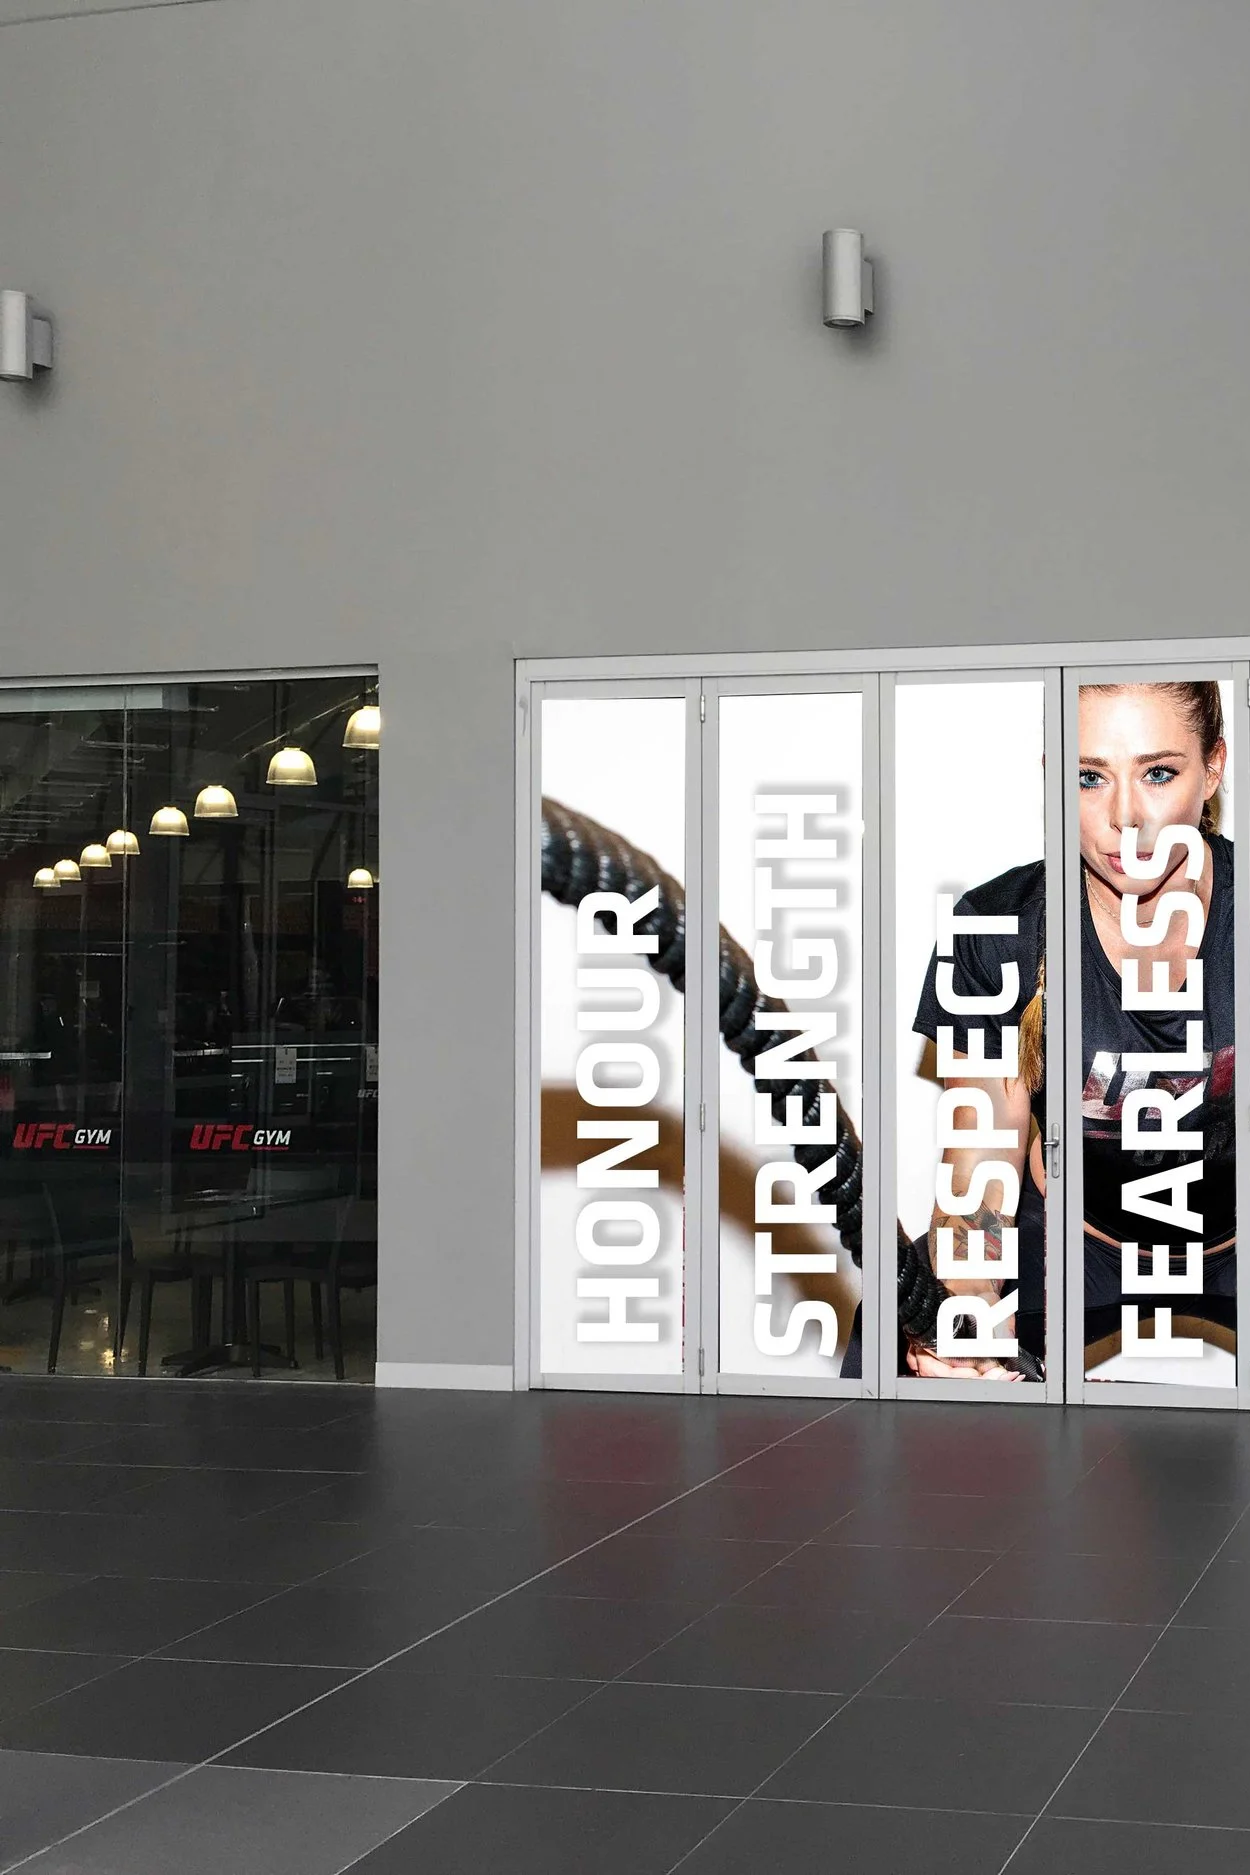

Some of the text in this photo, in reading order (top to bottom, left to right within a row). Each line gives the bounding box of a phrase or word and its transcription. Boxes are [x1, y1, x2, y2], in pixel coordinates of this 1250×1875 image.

[13, 1123, 112, 1149] UFC GYM
[189, 1124, 291, 1150] UFC GYM
[576, 883, 662, 1343] HONOUR
[753, 793, 839, 1357] STRENGTH
[935, 893, 1021, 1359] RESPECT
[1120, 823, 1206, 1358] FEARLESS
